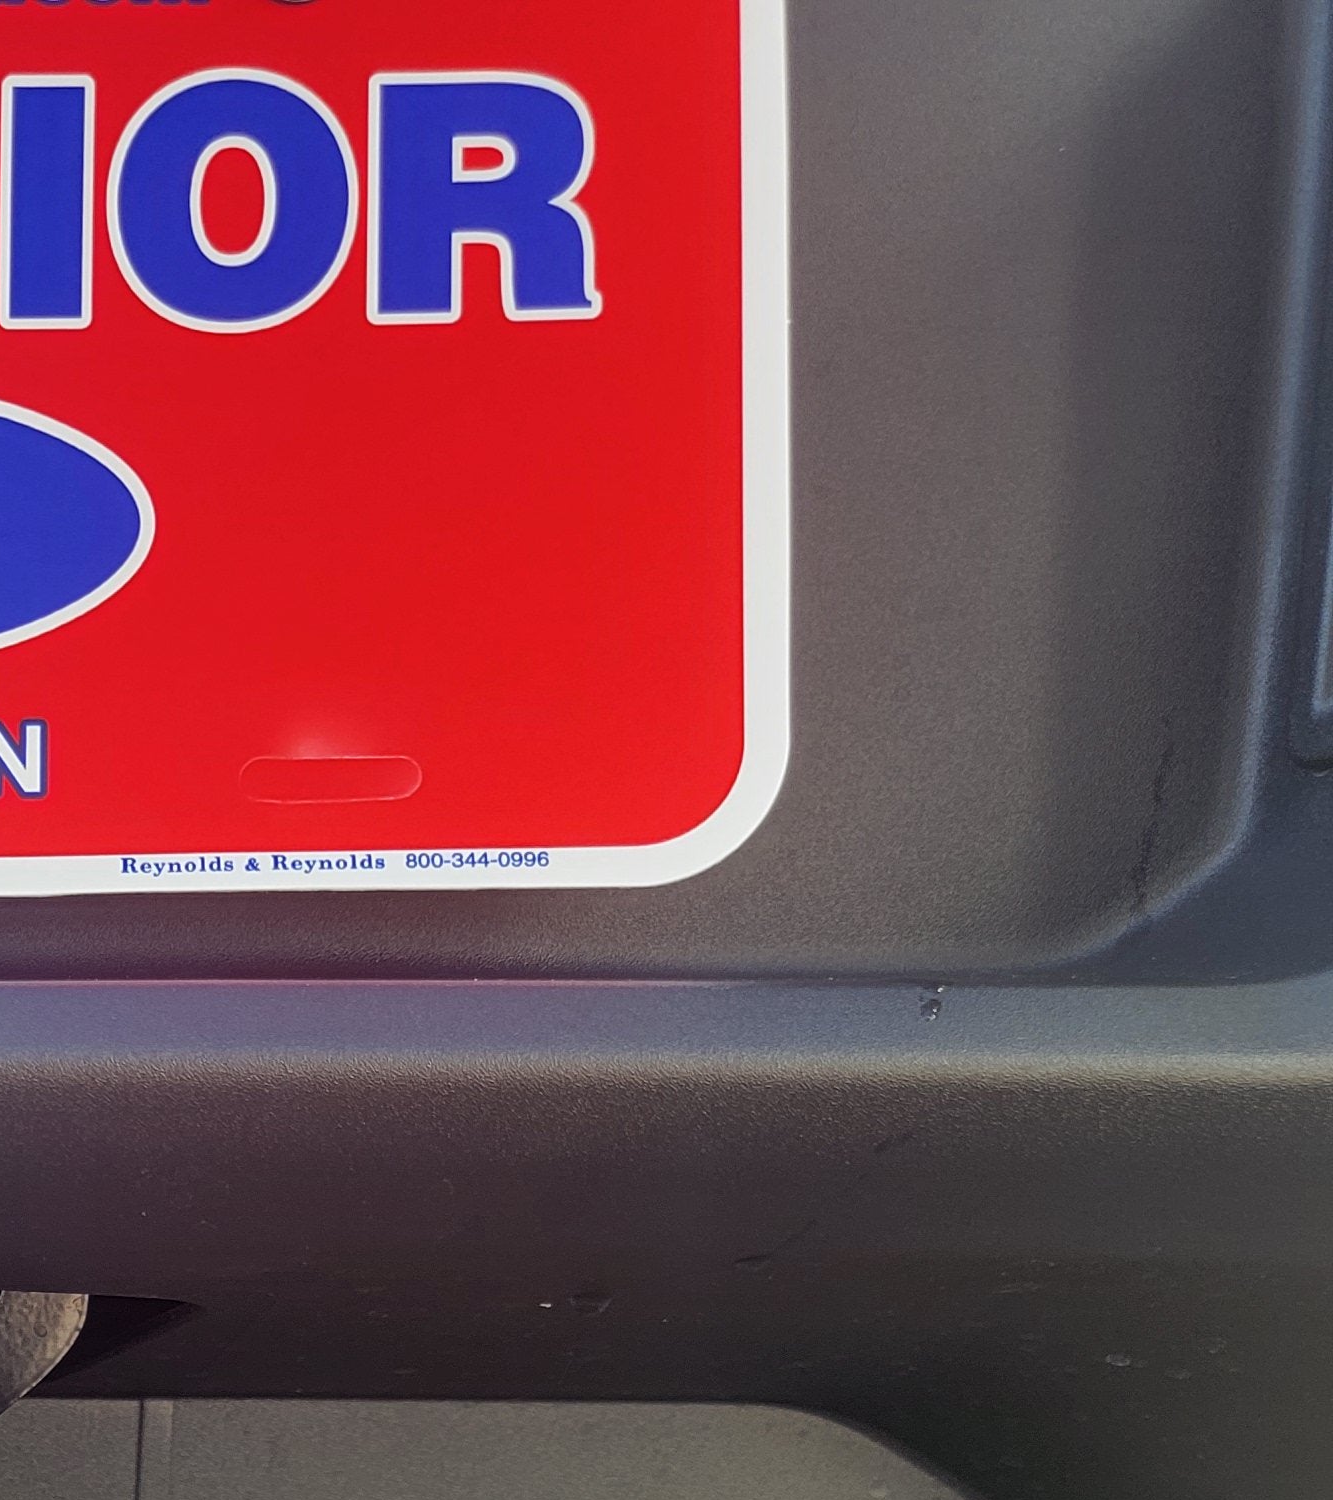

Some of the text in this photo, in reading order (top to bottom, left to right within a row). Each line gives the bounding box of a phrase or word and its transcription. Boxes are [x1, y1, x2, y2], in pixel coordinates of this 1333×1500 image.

[120, 851, 550, 876] Reynolds & Reynolds 800-344-0996
